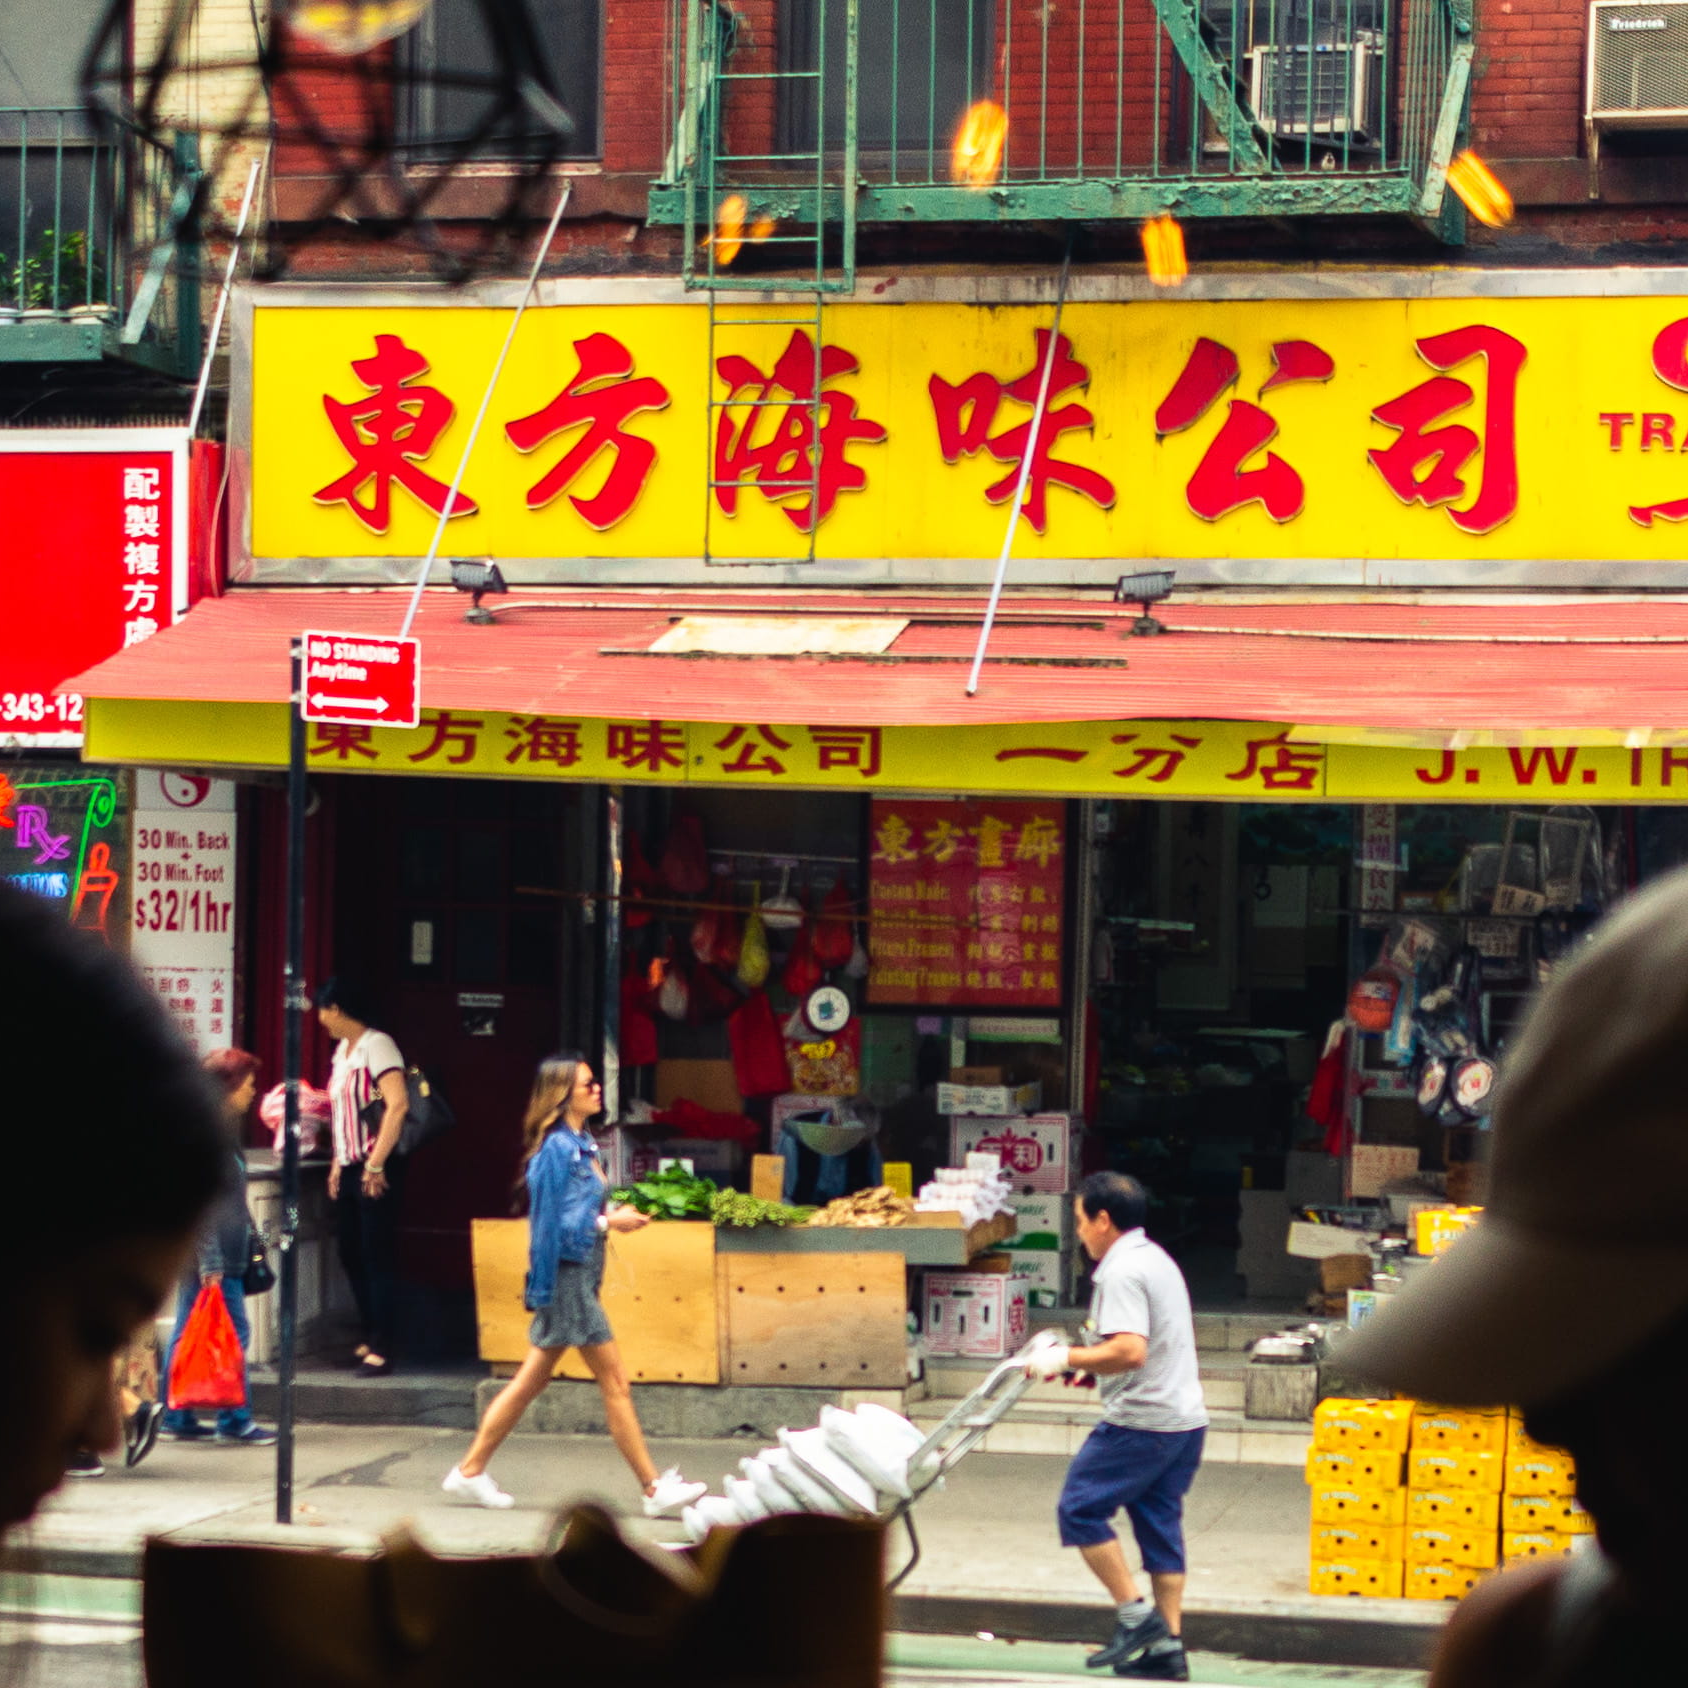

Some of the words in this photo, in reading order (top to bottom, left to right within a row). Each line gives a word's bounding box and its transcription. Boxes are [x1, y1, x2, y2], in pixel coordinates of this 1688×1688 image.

[313, 324, 1527, 536] 東方海味公司
[309, 640, 332, 659] NO
[333, 642, 400, 665] STANDING
[311, 660, 367, 682] Anytime
[311, 711, 881, 778] 東方海味公司
[138, 829, 162, 850] 30
[165, 831, 193, 850] Min.
[197, 831, 231, 850] Back
[138, 862, 162, 881] 30
[165, 863, 193, 882] Min.
[195, 863, 224, 883] Foot
